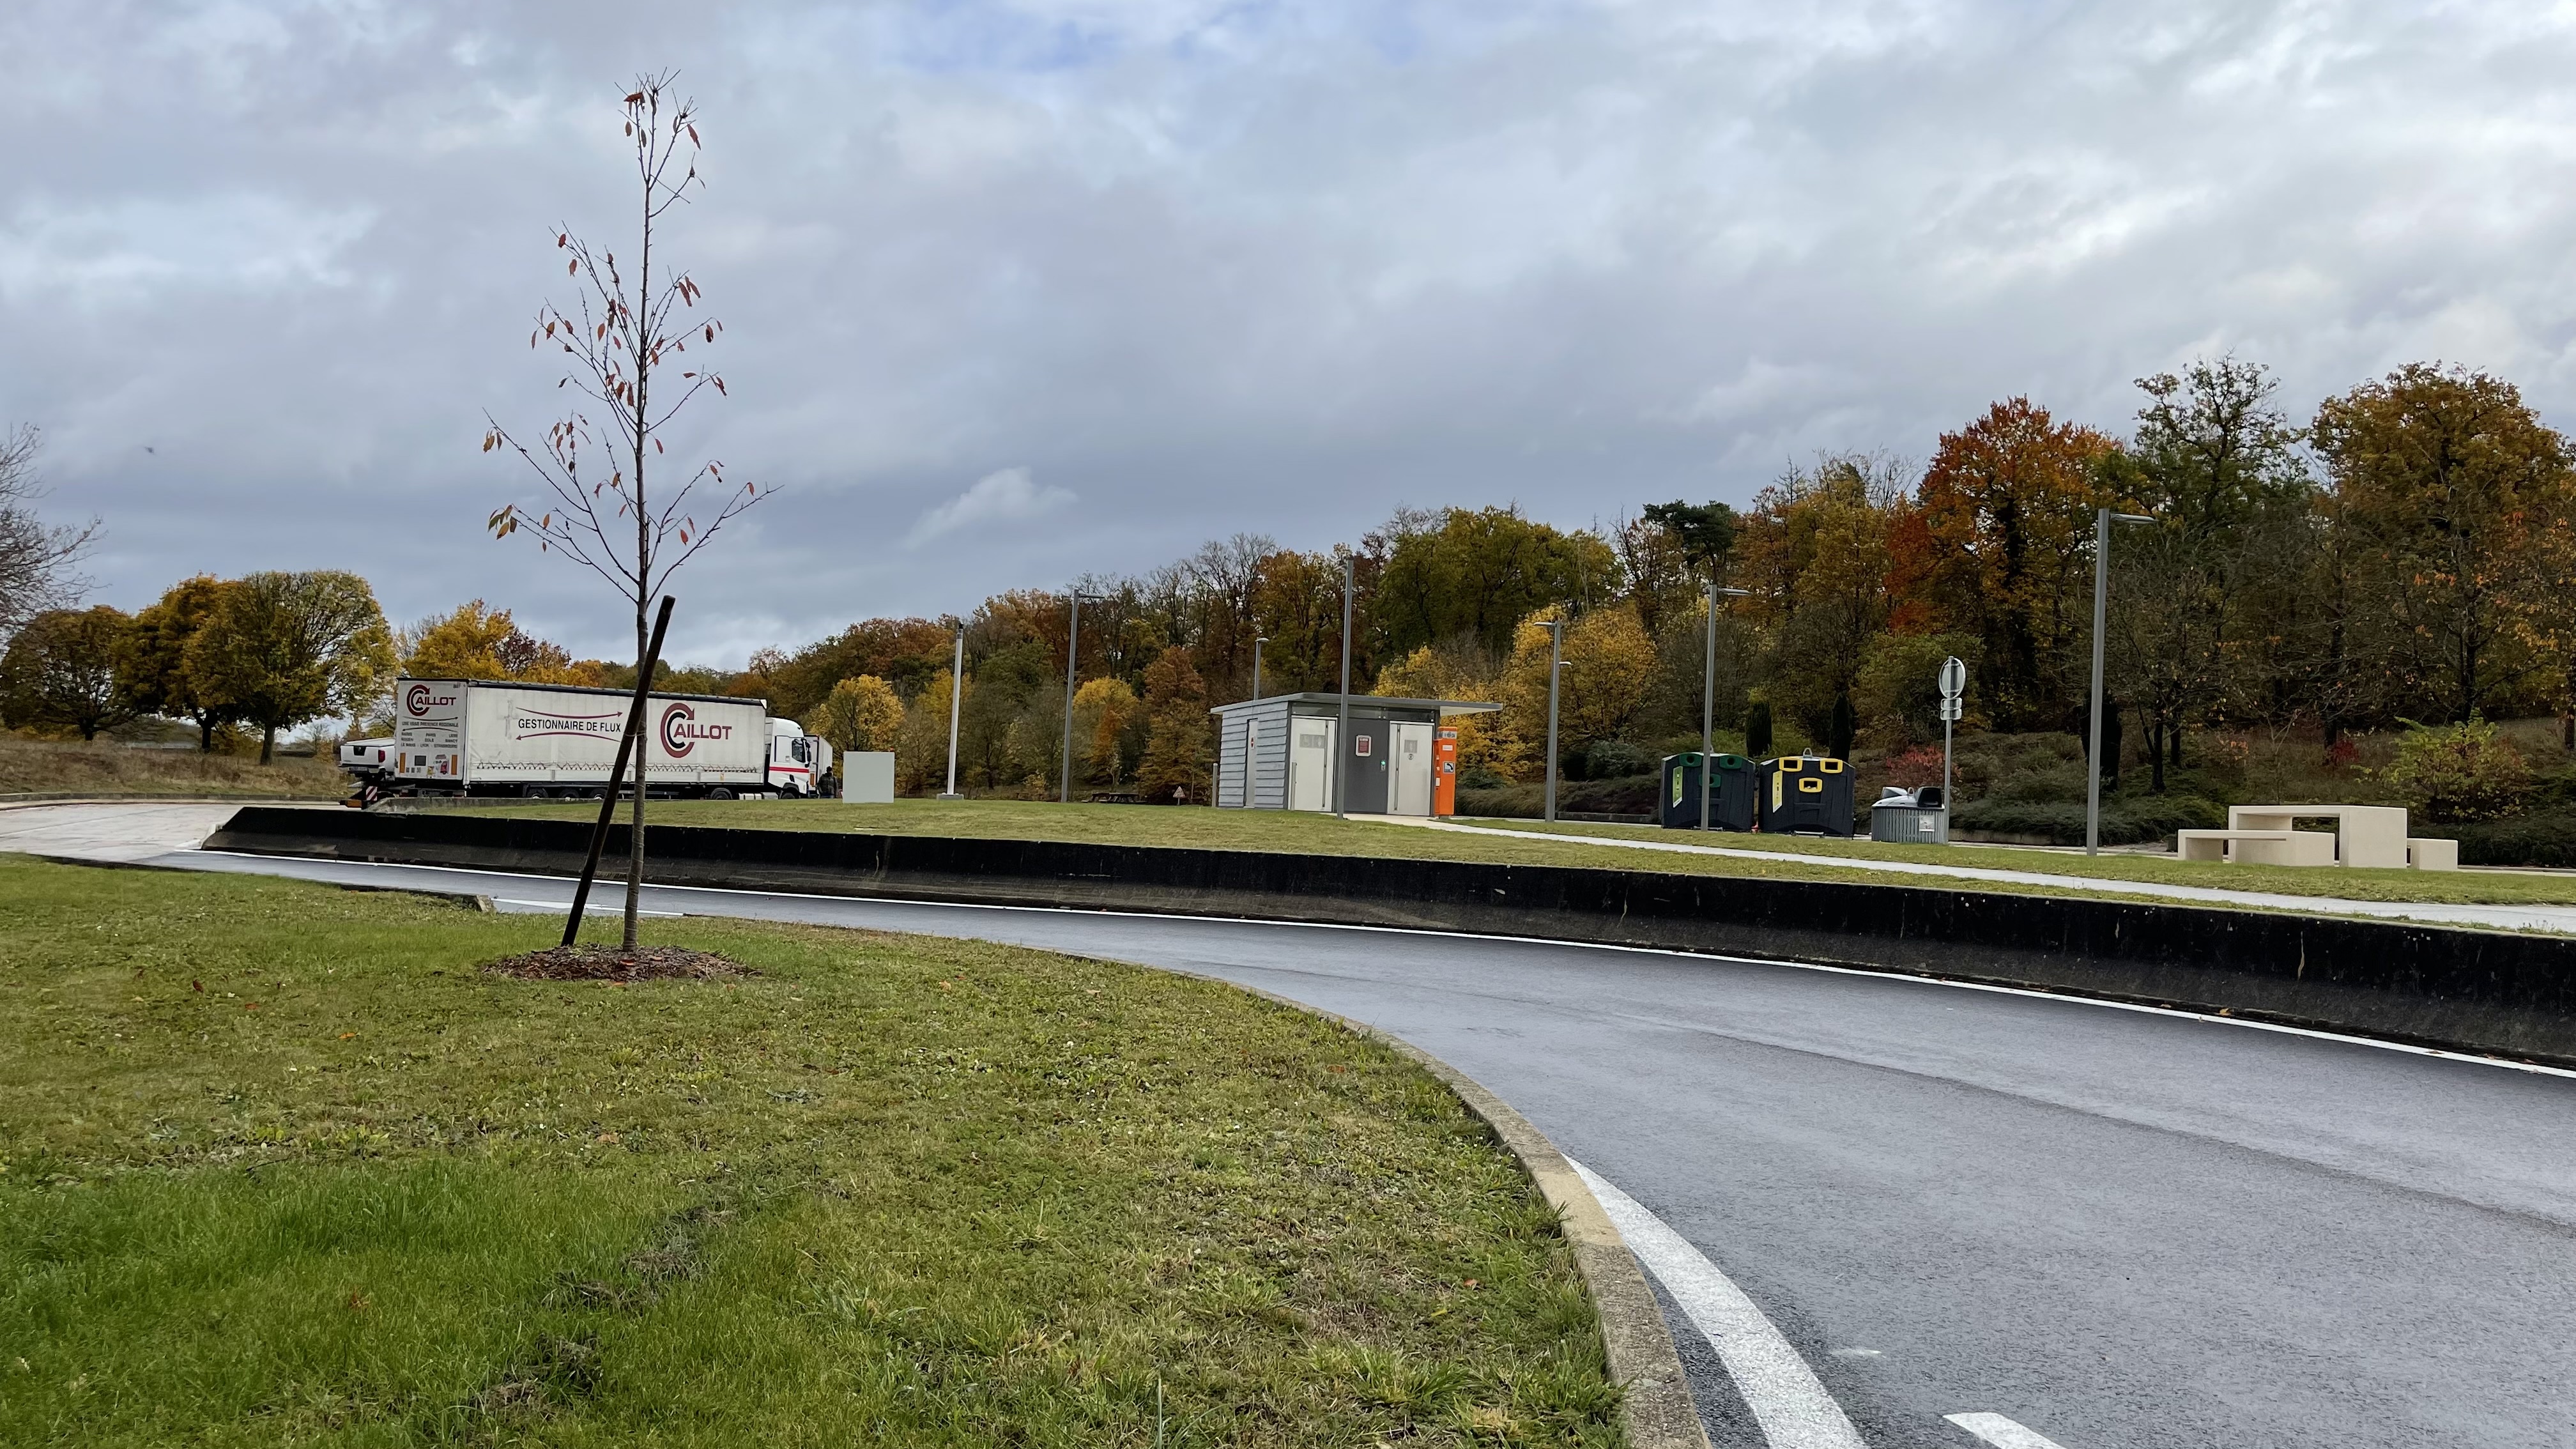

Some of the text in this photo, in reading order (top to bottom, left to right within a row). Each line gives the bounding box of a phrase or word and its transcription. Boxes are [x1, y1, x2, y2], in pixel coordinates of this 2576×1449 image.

[407, 684, 456, 716] CAILLOT
[518, 719, 621, 732] GESTIONNAIRE DE FLUX
[660, 702, 732, 758] CAILLOT
